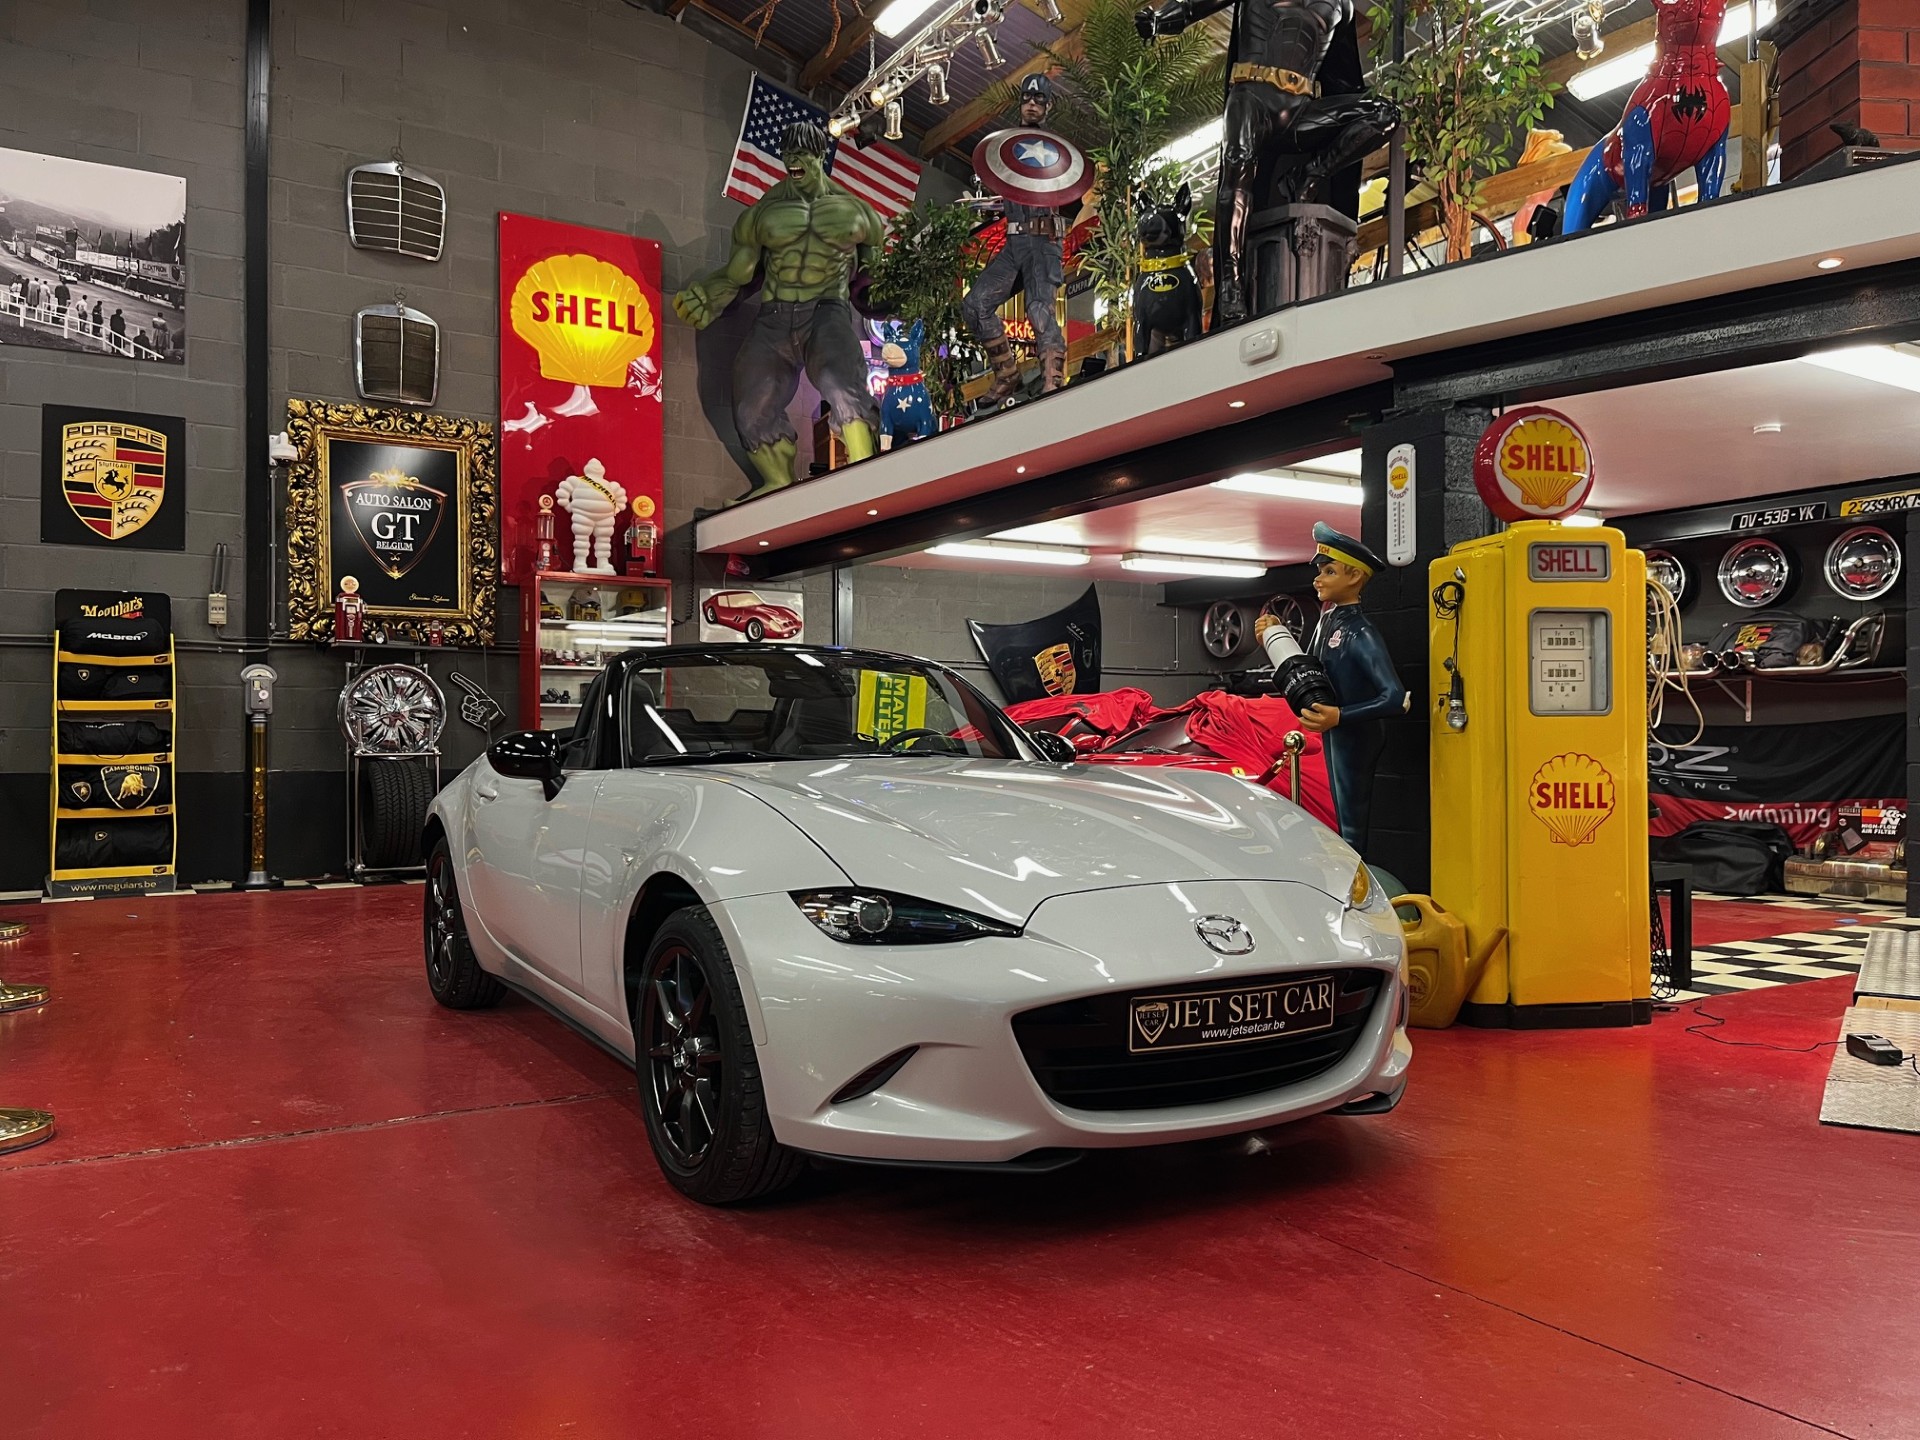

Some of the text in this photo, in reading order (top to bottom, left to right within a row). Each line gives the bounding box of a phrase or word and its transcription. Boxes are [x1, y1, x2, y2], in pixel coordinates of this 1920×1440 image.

[532, 291, 643, 337] SHELL
[66, 424, 164, 448] PORSCHE
[98, 461, 132, 469] STUTTGART
[1507, 444, 1581, 473] SHELL
[1391, 473, 1408, 481] SHELL
[356, 492, 432, 510] AUTO SALON
[371, 512, 420, 541] GT
[376, 540, 413, 551] BELGIUM
[1537, 549, 1598, 573] SHELL
[86, 631, 142, 641] McLaren
[878, 676, 893, 746] FILTER
[892, 678, 907, 735] MAN
[104, 765, 156, 774] LAMBORGHINI
[1648, 777, 1731, 791] CING
[1536, 782, 1608, 809] SHELL
[70, 881, 157, 892] www.meguiars.be
[1139, 1010, 1166, 1020] JET SET
[1169, 983, 1332, 1030] JET SET CAR
[1144, 1019, 1160, 1027] CAR
[1201, 1019, 1286, 1039] www.jetsetcar.be
